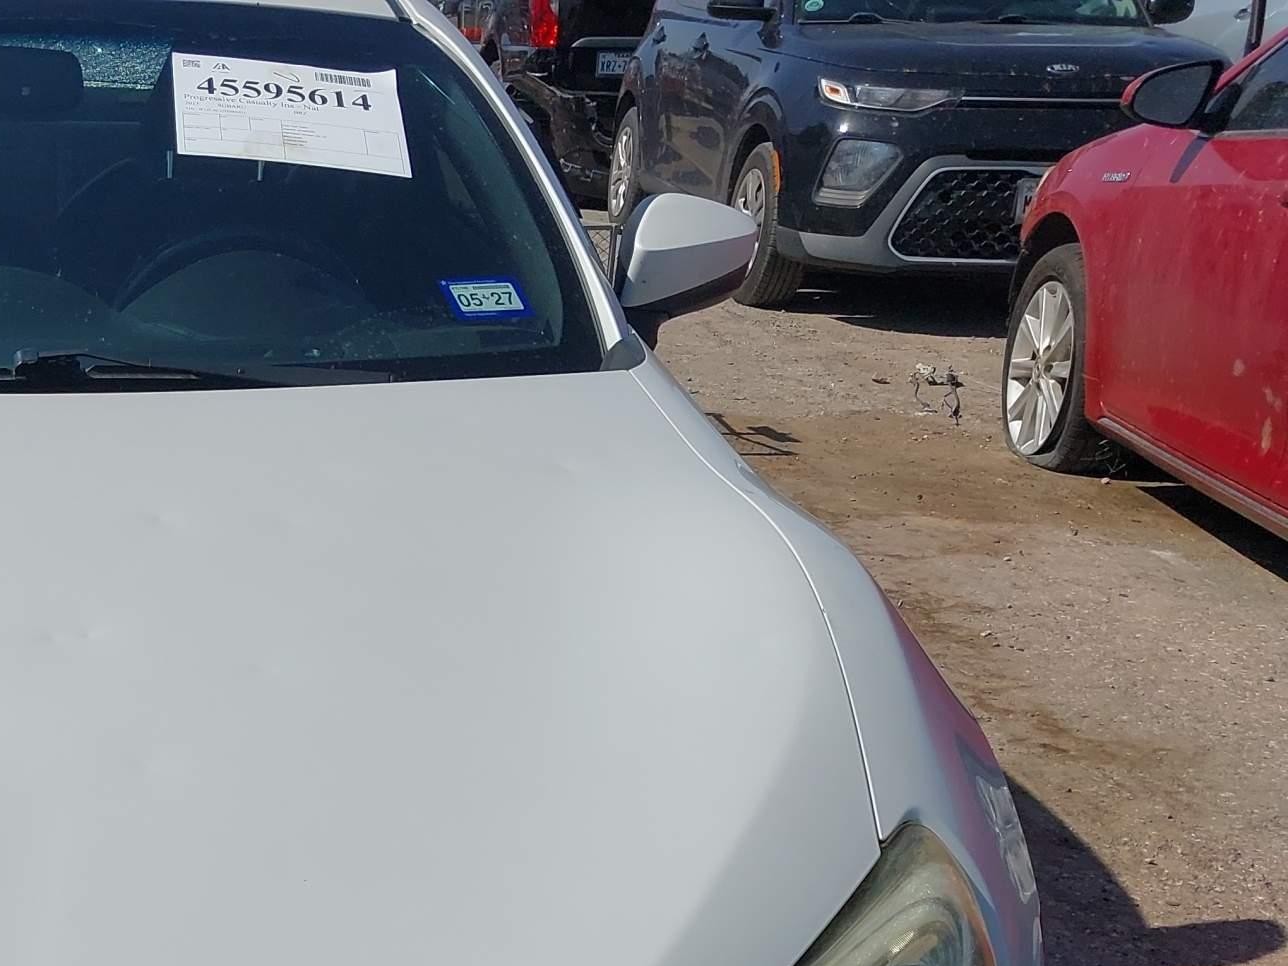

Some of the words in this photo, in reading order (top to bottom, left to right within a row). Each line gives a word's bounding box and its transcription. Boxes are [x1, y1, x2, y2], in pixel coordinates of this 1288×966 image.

[184, 93, 236, 104] Progressive
[238, 98, 277, 108] Casualty
[197, 77, 372, 111] 45595614
[457, 293, 483, 307] 05
[491, 292, 513, 306] 27
